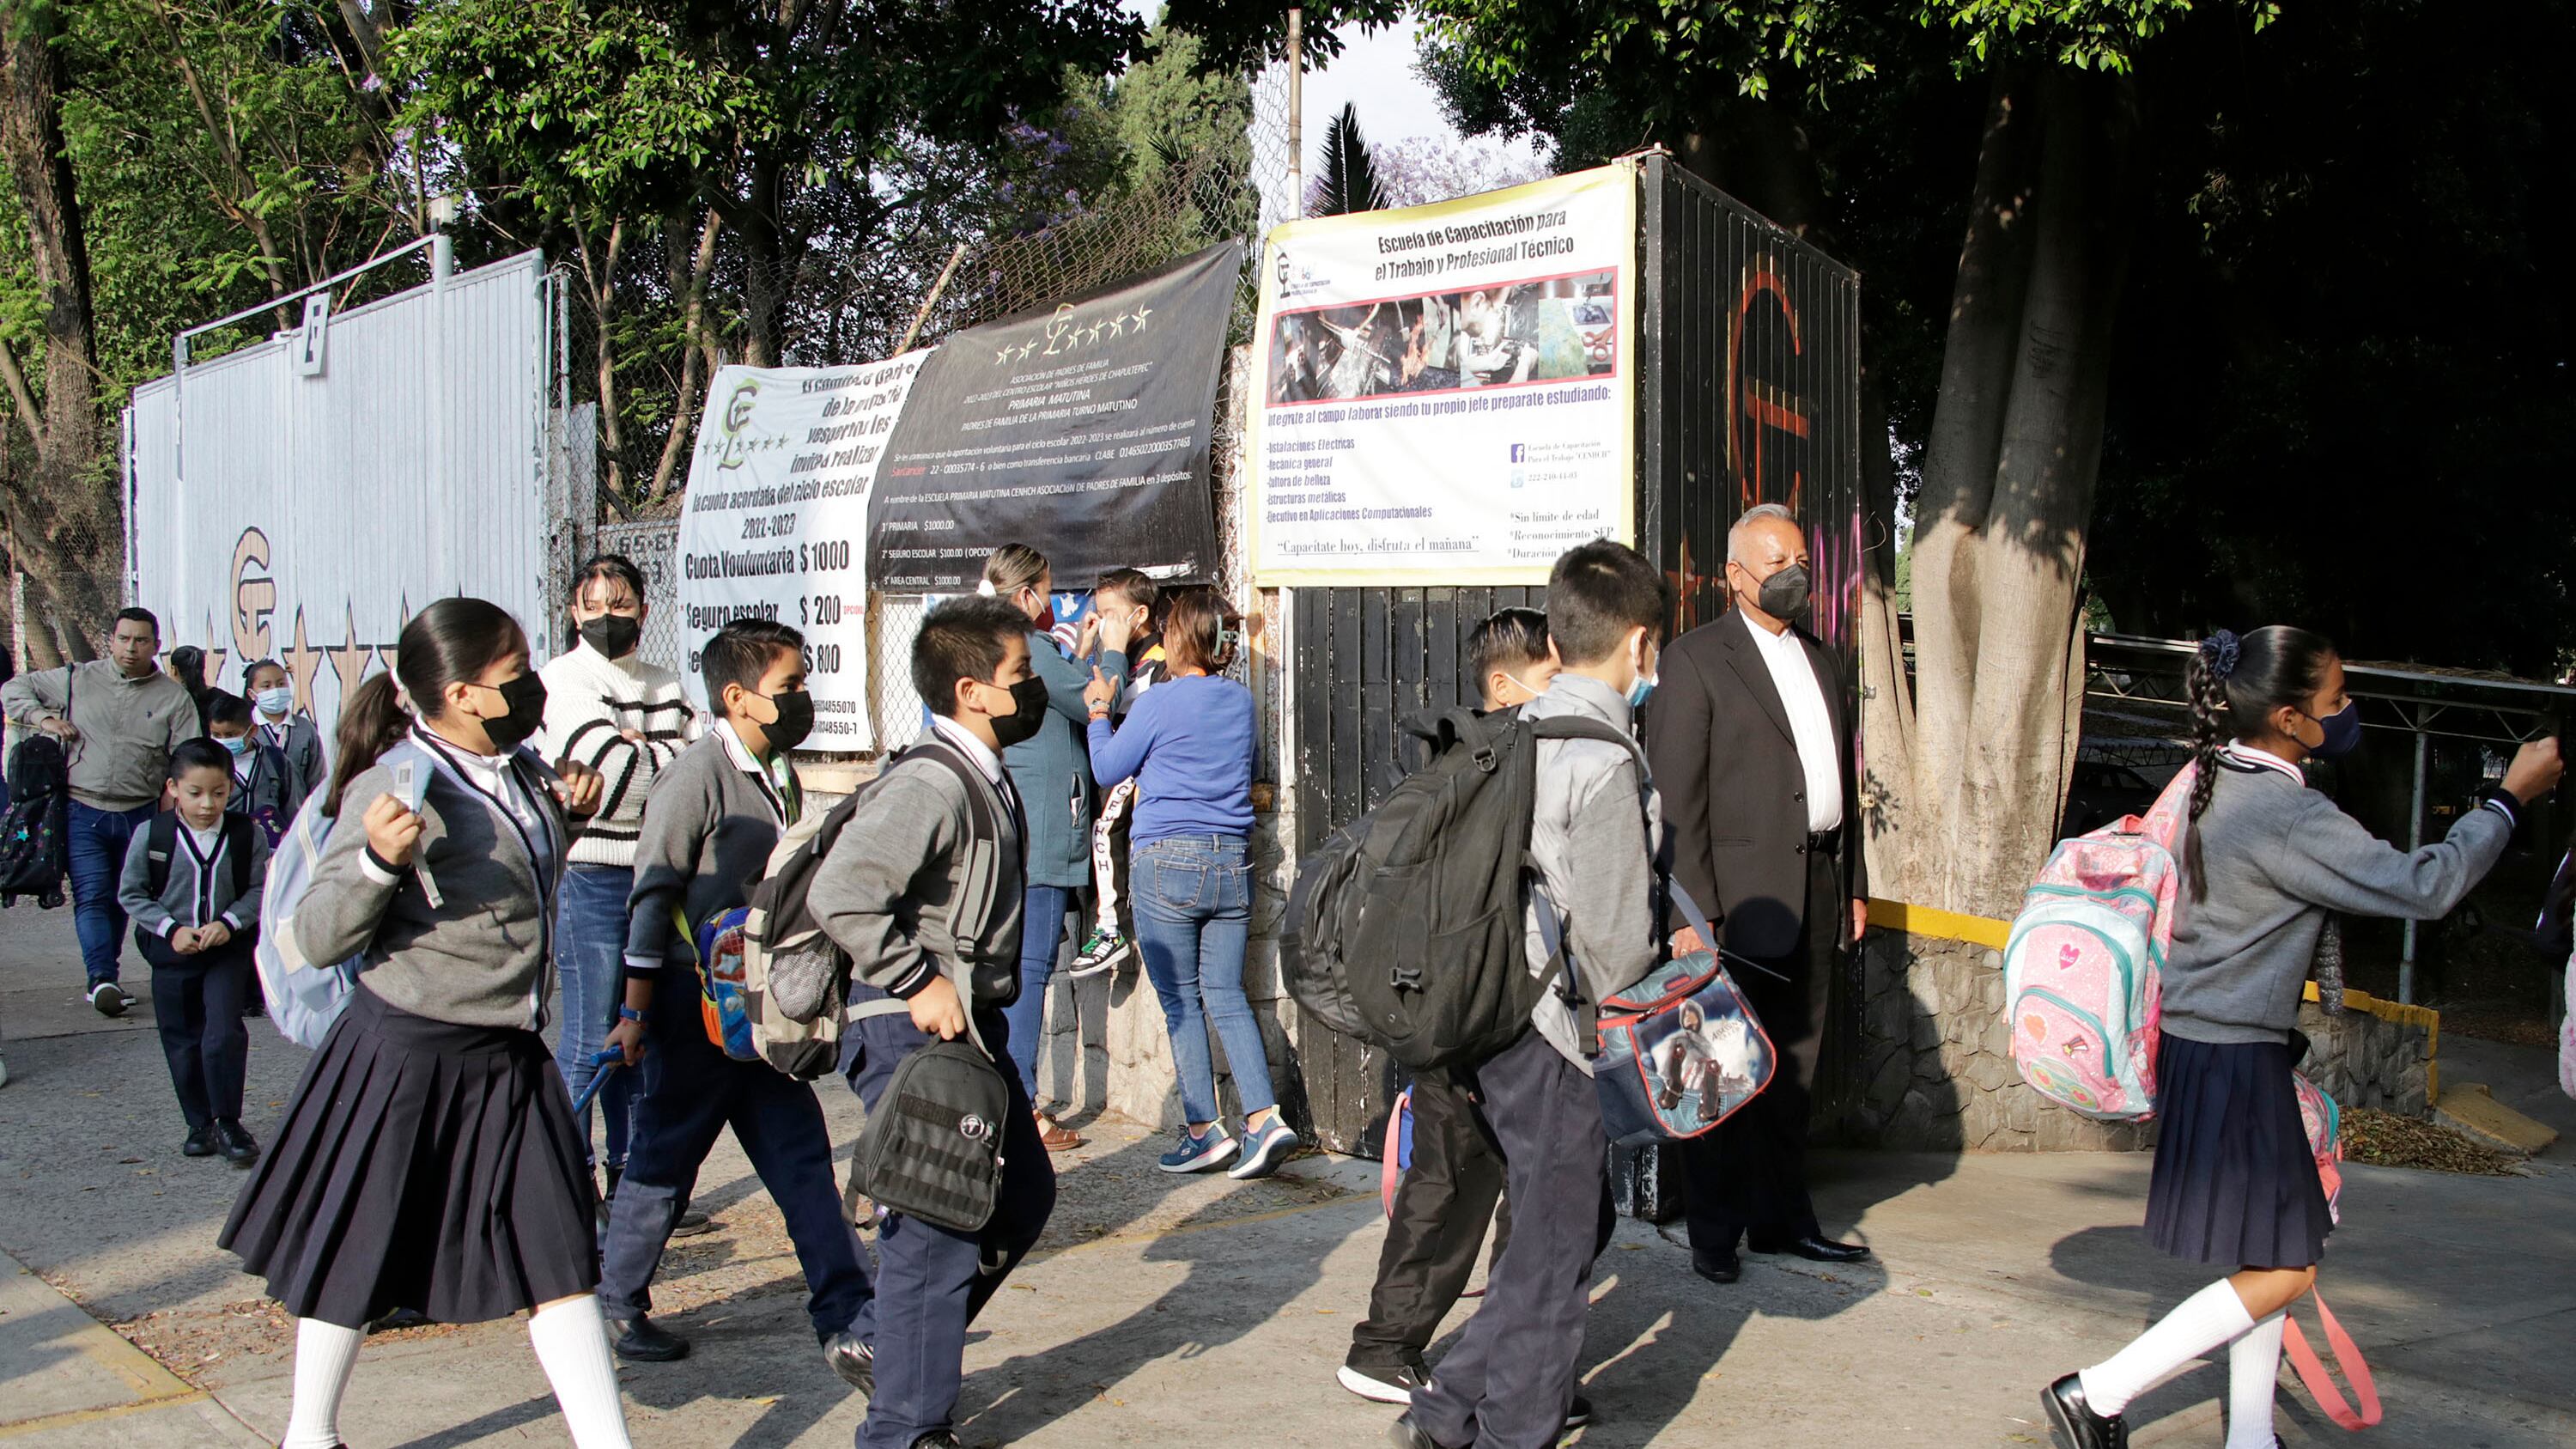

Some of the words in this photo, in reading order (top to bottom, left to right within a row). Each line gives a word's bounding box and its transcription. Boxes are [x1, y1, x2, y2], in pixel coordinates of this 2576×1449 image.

[1378, 231, 1425, 254] Escuela
[1428, 229, 1443, 247] de
[1445, 214, 1534, 244] Capacitación
[1537, 210, 1566, 232] para
[1376, 263, 1387, 281] el
[1388, 257, 1434, 279] Trabajo
[1437, 258, 1444, 275] y
[1447, 243, 1517, 271] Profesional
[1521, 236, 1574, 259] Técnico
[1046, 371, 1055, 380] DE
[1055, 366, 1077, 378] PADRES
[1076, 364, 1085, 373] DE
[1085, 359, 1109, 371] FAMILIA
[1002, 386, 1026, 397] CENTRO
[1026, 383, 1052, 393] ESCOLAR
[1098, 373, 1107, 381] DE
[822, 397, 841, 418] de
[1008, 396, 1045, 411] PRIMARIA
[1048, 389, 1091, 406] MATUTINA
[1306, 410, 1315, 423] al
[1318, 409, 1346, 424] campo
[1385, 402, 1419, 419] siendo
[1421, 402, 1431, 416] tu
[1433, 398, 1466, 417] propio
[1468, 395, 1489, 414] jefe
[1491, 392, 1544, 411] preparate
[1546, 385, 1612, 405] estudiando:
[870, 414, 891, 435] les
[961, 421, 986, 431] PADRES
[985, 419, 993, 429] DE
[993, 417, 1018, 429] FAMILIA
[1019, 414, 1028, 423] DE
[1029, 413, 1037, 422] LA
[1037, 407, 1071, 421] PRIMARIA
[1072, 404, 1097, 417] TURNO
[1097, 398, 1138, 414] MATUTINO
[935, 451, 945, 460] que
[983, 443, 1011, 454] voluntaria
[1012, 443, 1025, 454] para
[1025, 441, 1032, 449] el
[1031, 439, 1046, 449] ciclo
[1046, 436, 1070, 447] escolar
[1104, 433, 1113, 441] se
[1139, 427, 1145, 435] al
[1169, 422, 1177, 431] de
[1177, 418, 1195, 430] cuenta
[830, 445, 880, 468] realizar
[930, 465, 939, 475] 22
[980, 461, 985, 472] 6
[993, 460, 1005, 471] bien
[1007, 460, 1023, 470] como
[1024, 454, 1063, 467] transferencia
[1064, 454, 1091, 464] bancaria
[1095, 449, 1115, 461] CLABE
[1303, 455, 1333, 471] general
[919, 494, 925, 503] la
[925, 491, 949, 502] ESCUELA
[950, 489, 979, 501] PRIMARIA
[979, 488, 1010, 499] MATUTINA
[1011, 485, 1036, 496] CENHCH
[1076, 482, 1085, 492] DE
[1086, 479, 1109, 491] PADRES
[1110, 478, 1118, 488] DE
[1119, 475, 1145, 488] FAMILIA
[1146, 476, 1155, 484] en
[1155, 474, 1160, 484] 3
[1292, 475, 1302, 487] de
[1304, 473, 1331, 486] belleza
[692, 493, 701, 513] la
[701, 491, 729, 512] cuota
[793, 478, 821, 502] ciclo
[821, 474, 869, 498] escolar
[1308, 490, 1346, 504] metálicas
[1299, 511, 1308, 521] en
[1309, 508, 1359, 522] Aplicaciones
[1362, 505, 1432, 521] Computacionales
[1563, 509, 1573, 521] de
[1577, 508, 1599, 521] edad
[889, 521, 918, 532] PRIMARIA
[924, 520, 954, 532] $1000.00
[889, 549, 910, 559] SEGURO
[912, 549, 936, 558] ESCOLAR
[939, 547, 963, 559] $100.00
[969, 547, 999, 557] OPCIONA
[1340, 538, 1364, 555] hoy,
[1367, 537, 1410, 552] disfruta
[1415, 537, 1425, 551] el
[685, 552, 720, 581] Cuota
[720, 545, 795, 578] Vouluntaria
[811, 540, 849, 572] 1000
[890, 575, 905, 586] AREA
[905, 575, 929, 586] CENTRAL
[934, 575, 961, 586] $1000.00
[686, 602, 730, 632] Seguro
[733, 600, 779, 624] escolar
[799, 594, 808, 628] $
[814, 594, 841, 625] 200
[804, 642, 813, 676] $
[817, 643, 841, 674] 800
